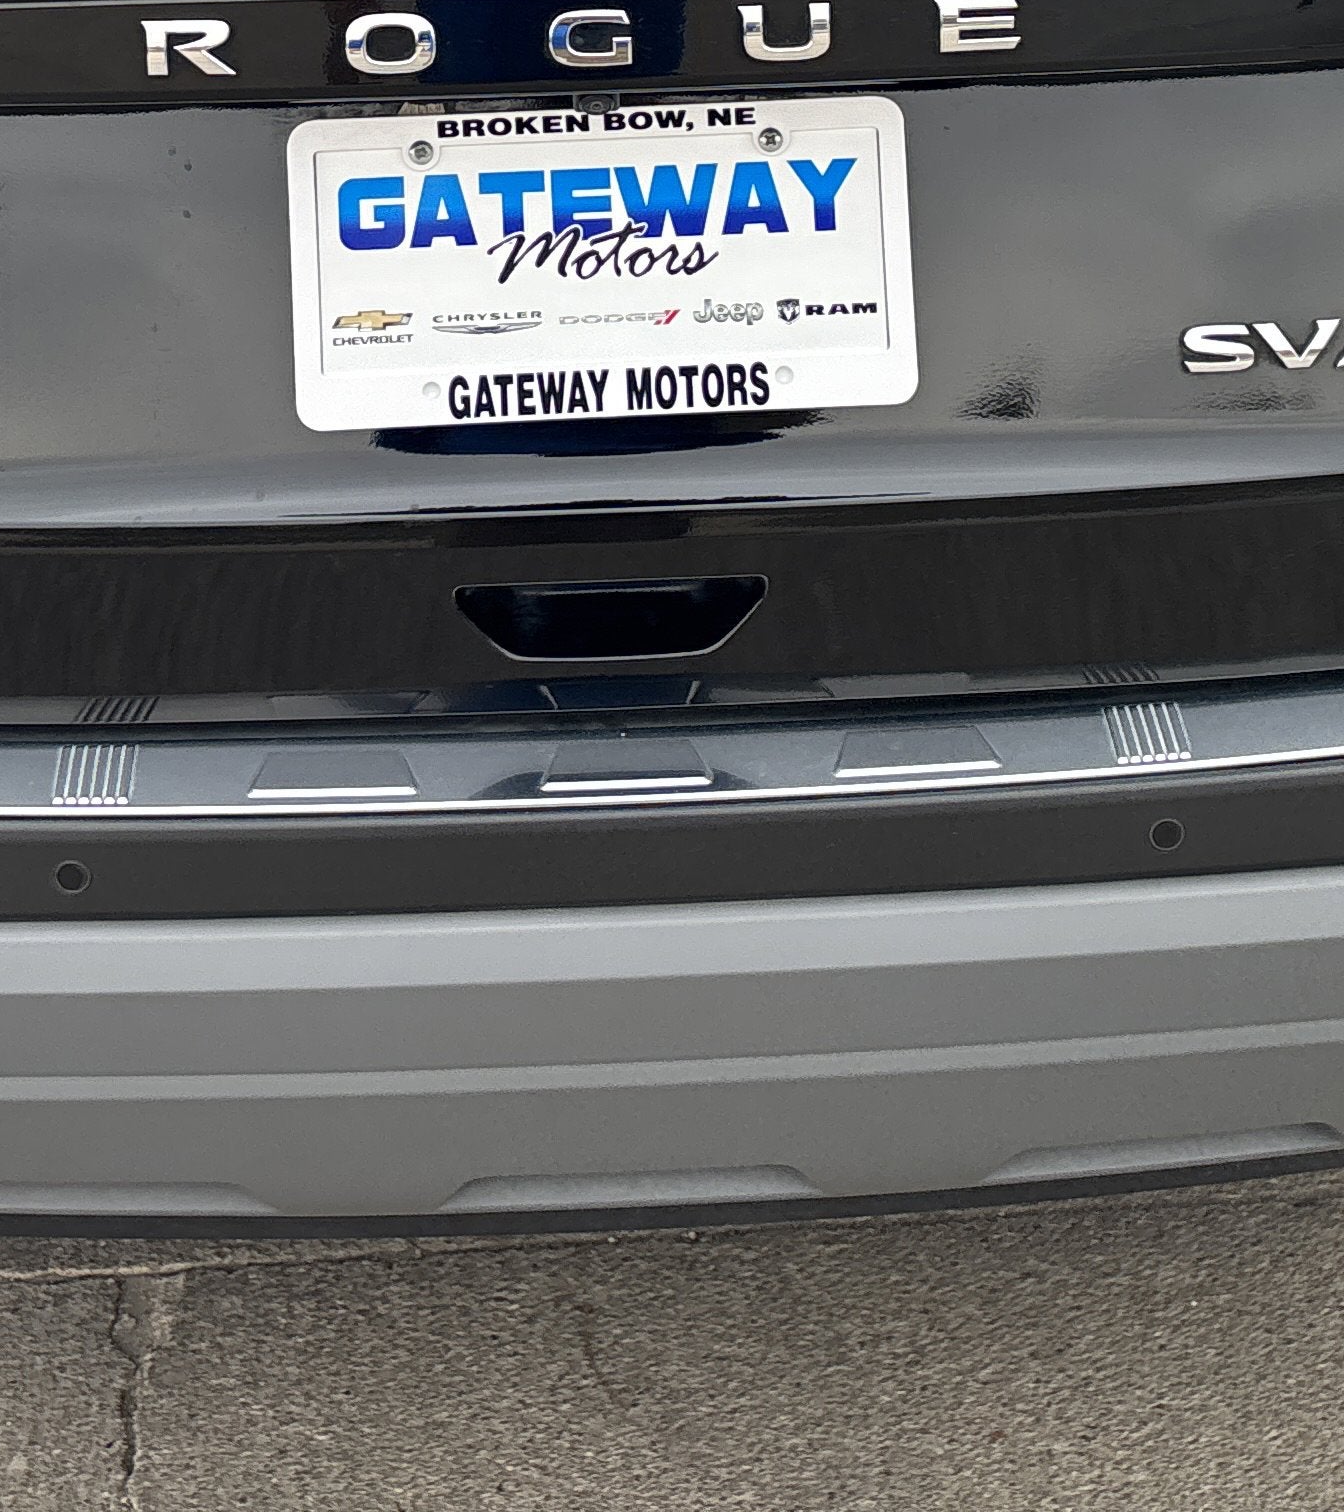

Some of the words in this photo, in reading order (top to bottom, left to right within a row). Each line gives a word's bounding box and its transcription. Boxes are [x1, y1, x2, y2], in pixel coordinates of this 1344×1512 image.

[437, 114, 590, 138] BROKEN
[603, 109, 694, 133] BOW,
[707, 106, 756, 126] NE
[337, 157, 858, 251] GATEWAY
[488, 219, 719, 285] Motors
[432, 310, 543, 323] CHRYSLER
[559, 312, 666, 325] DODGE
[693, 298, 764, 326] Jeep
[805, 302, 878, 316] RAM
[332, 334, 414, 346] CHEVROLET
[448, 369, 609, 420] GATEWAY
[626, 361, 770, 410] MOTORS
